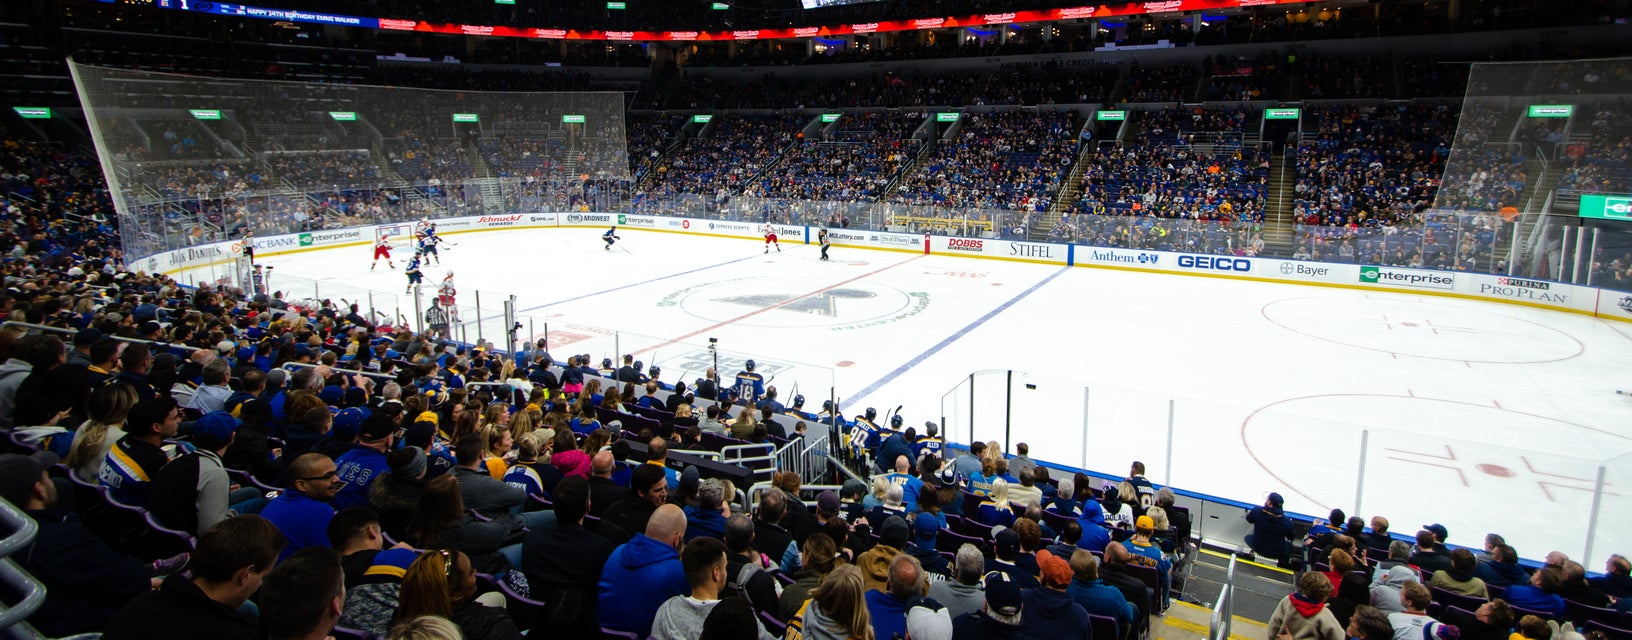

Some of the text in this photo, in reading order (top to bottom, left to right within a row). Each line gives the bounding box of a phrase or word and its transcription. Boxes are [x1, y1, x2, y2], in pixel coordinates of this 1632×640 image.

[247, 8, 268, 16] HAPPY
[477, 214, 524, 223] Schnucks
[300, 231, 360, 244] enterprise
[781, 227, 801, 236] Jones
[267, 236, 296, 249] BANK
[949, 238, 983, 249] DOBBS
[1009, 242, 1053, 259] STIFEL
[1090, 250, 1134, 264] Anthem
[1178, 255, 1250, 272] GEICO
[1297, 264, 1328, 276] Bayer
[1362, 270, 1453, 287] enterprise
[1508, 279, 1549, 290] PURINA
[1480, 284, 1567, 304] PRO PLAN
